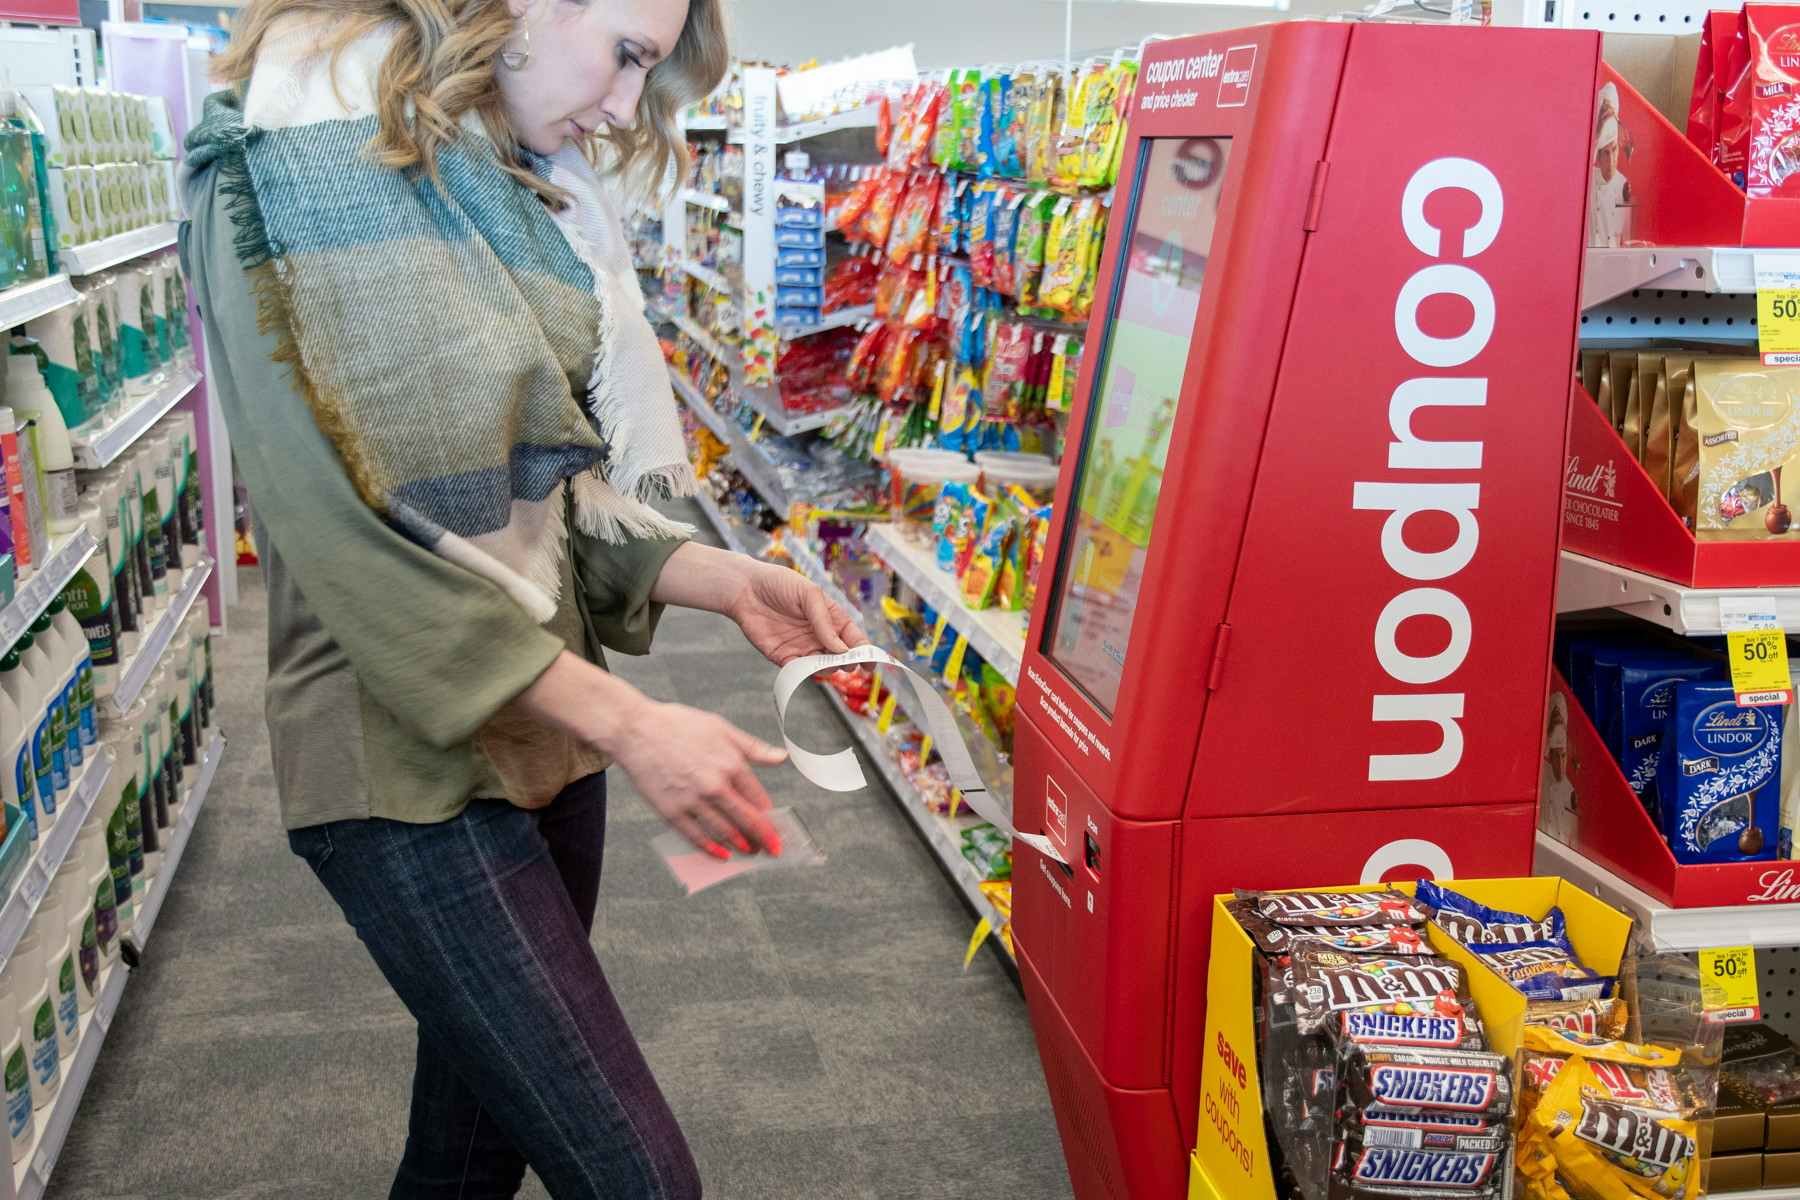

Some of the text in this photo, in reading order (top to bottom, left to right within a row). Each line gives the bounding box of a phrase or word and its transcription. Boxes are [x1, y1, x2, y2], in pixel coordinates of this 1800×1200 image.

[1146, 49, 1224, 88] coupon center
[1141, 88, 1198, 112] and price checker
[1762, 82, 1785, 97] MILK
[750, 161, 769, 217] chewy
[1704, 431, 1737, 445] ASSORTED
[1352, 157, 1504, 781] coupon
[1566, 511, 1600, 530] SINCE 1845
[1574, 500, 1619, 521] CHOCOLATIER
[1749, 694, 1780, 703] special
[1705, 711, 1746, 728] Lindt
[1634, 734, 1658, 749] DARK
[1707, 732, 1753, 744] LINDOR
[1689, 759, 1713, 774] DARK
[1350, 1014, 1456, 1041] SNICKERS
[1217, 1031, 1247, 1090] save
[1375, 1068, 1489, 1106] SNICKERS
[1219, 1077, 1240, 1126] with
[1205, 1092, 1254, 1178] coupons!
[1460, 1139, 1492, 1150] PACKED
[1359, 1150, 1485, 1185] SNICKERS
